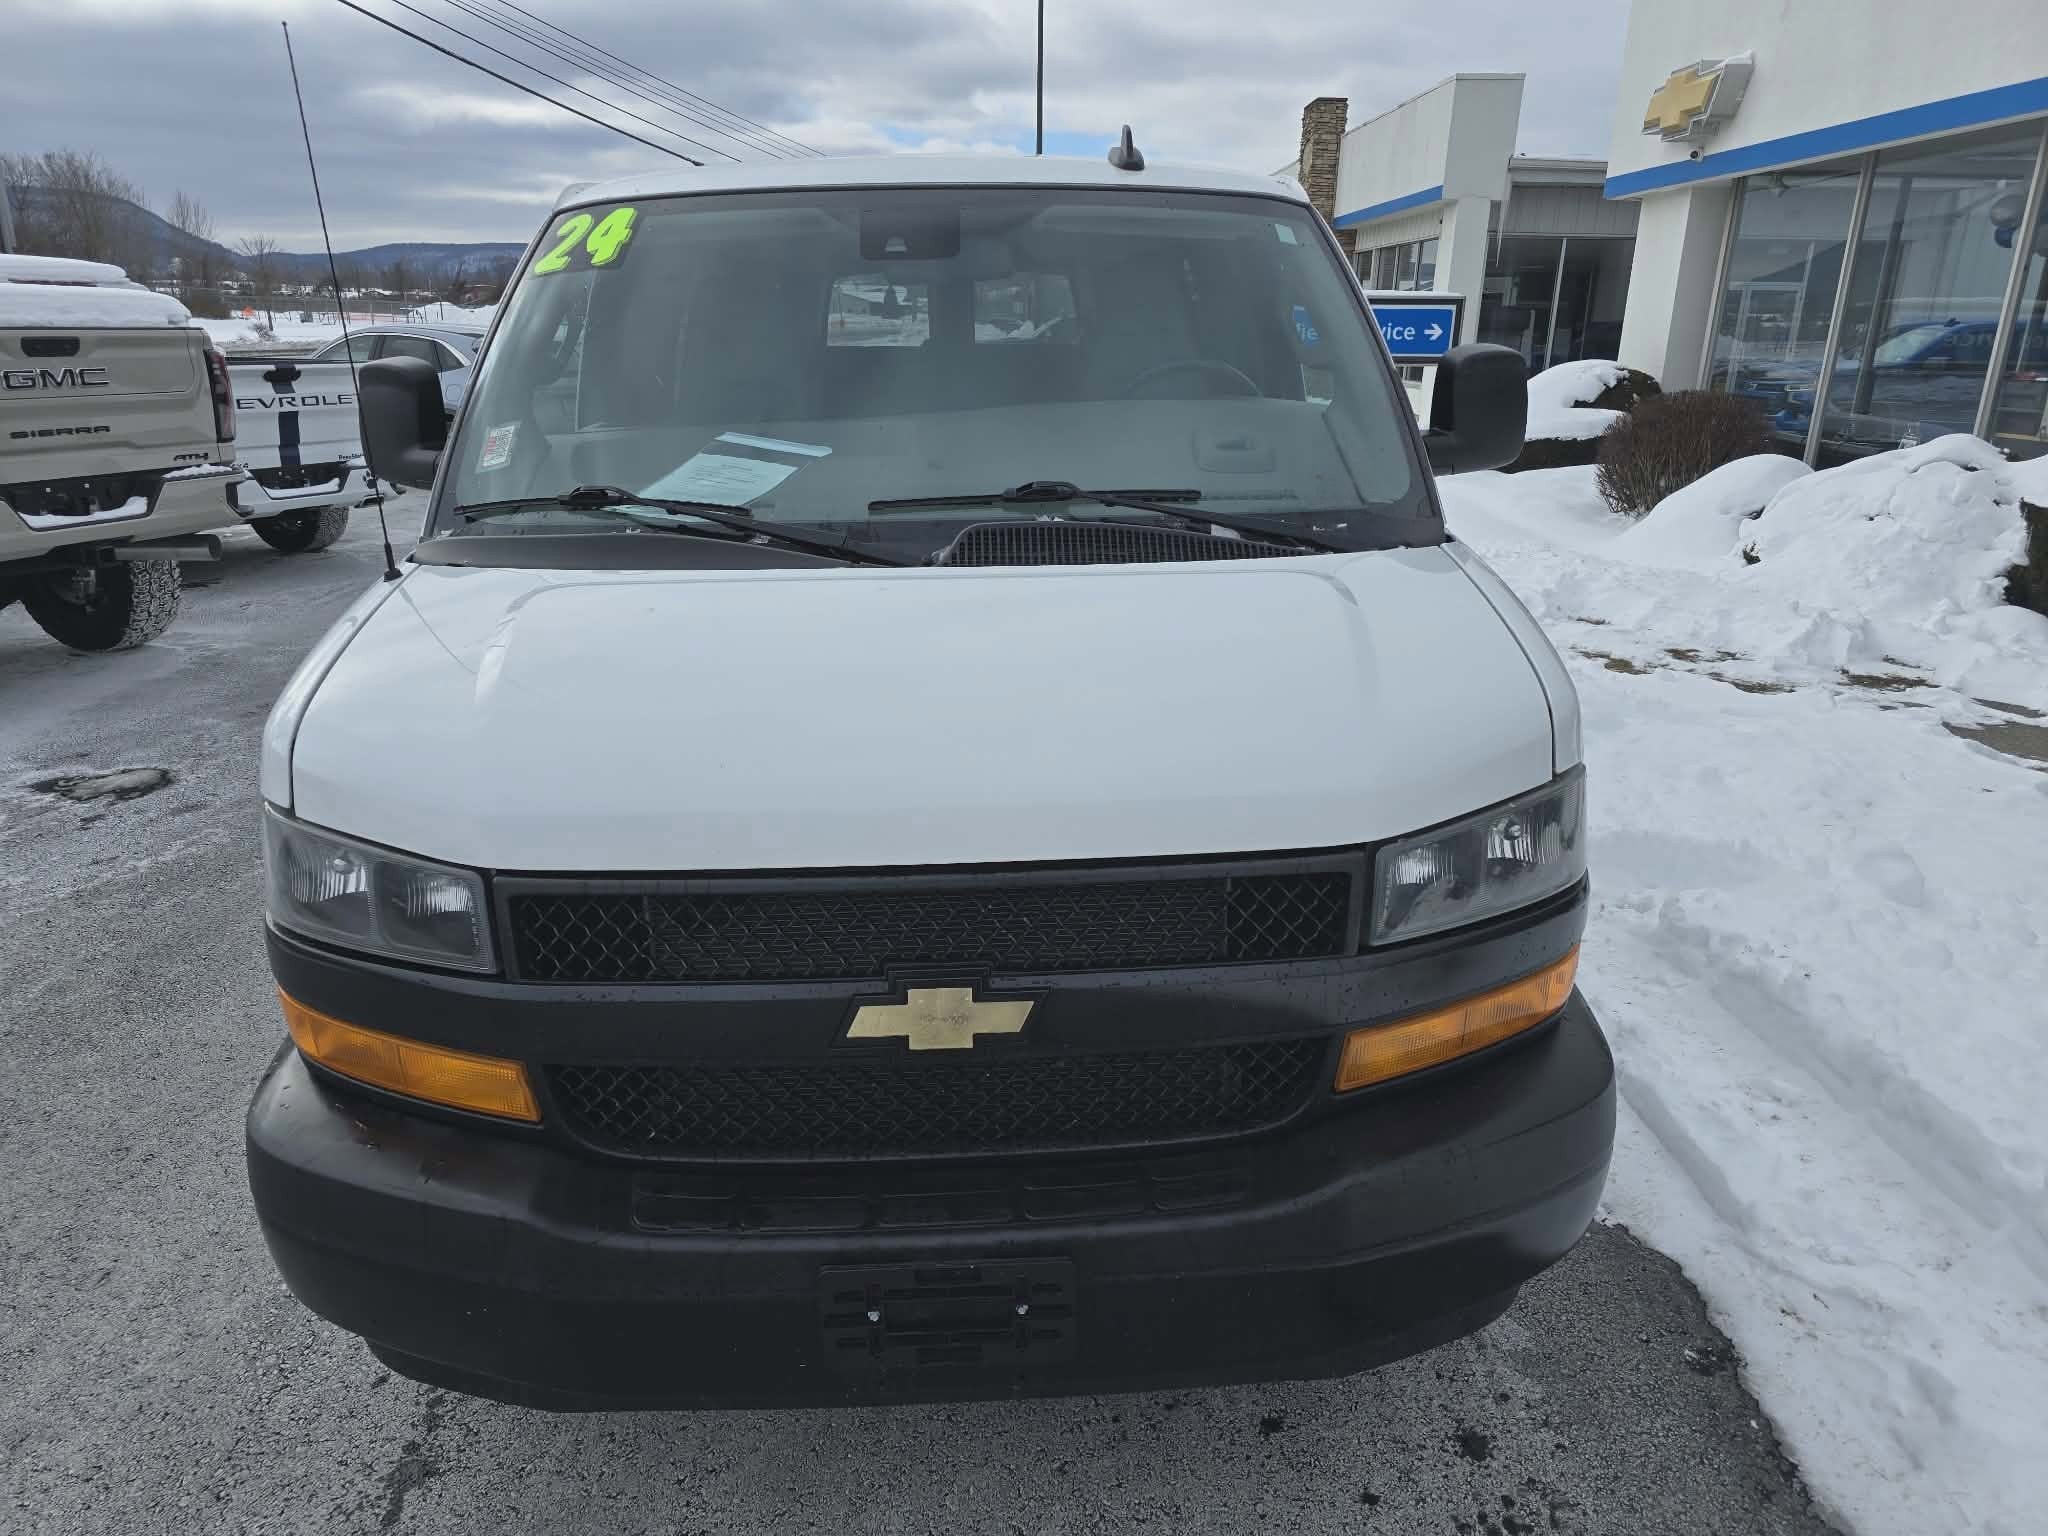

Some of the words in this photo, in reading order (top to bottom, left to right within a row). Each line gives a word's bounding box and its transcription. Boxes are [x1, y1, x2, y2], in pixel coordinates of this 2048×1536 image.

[534, 207, 637, 275] 24
[1379, 322, 1416, 341] vice
[1, 367, 109, 390] GMC
[235, 394, 354, 410] EVROLE
[10, 426, 110, 439] SIERRA
